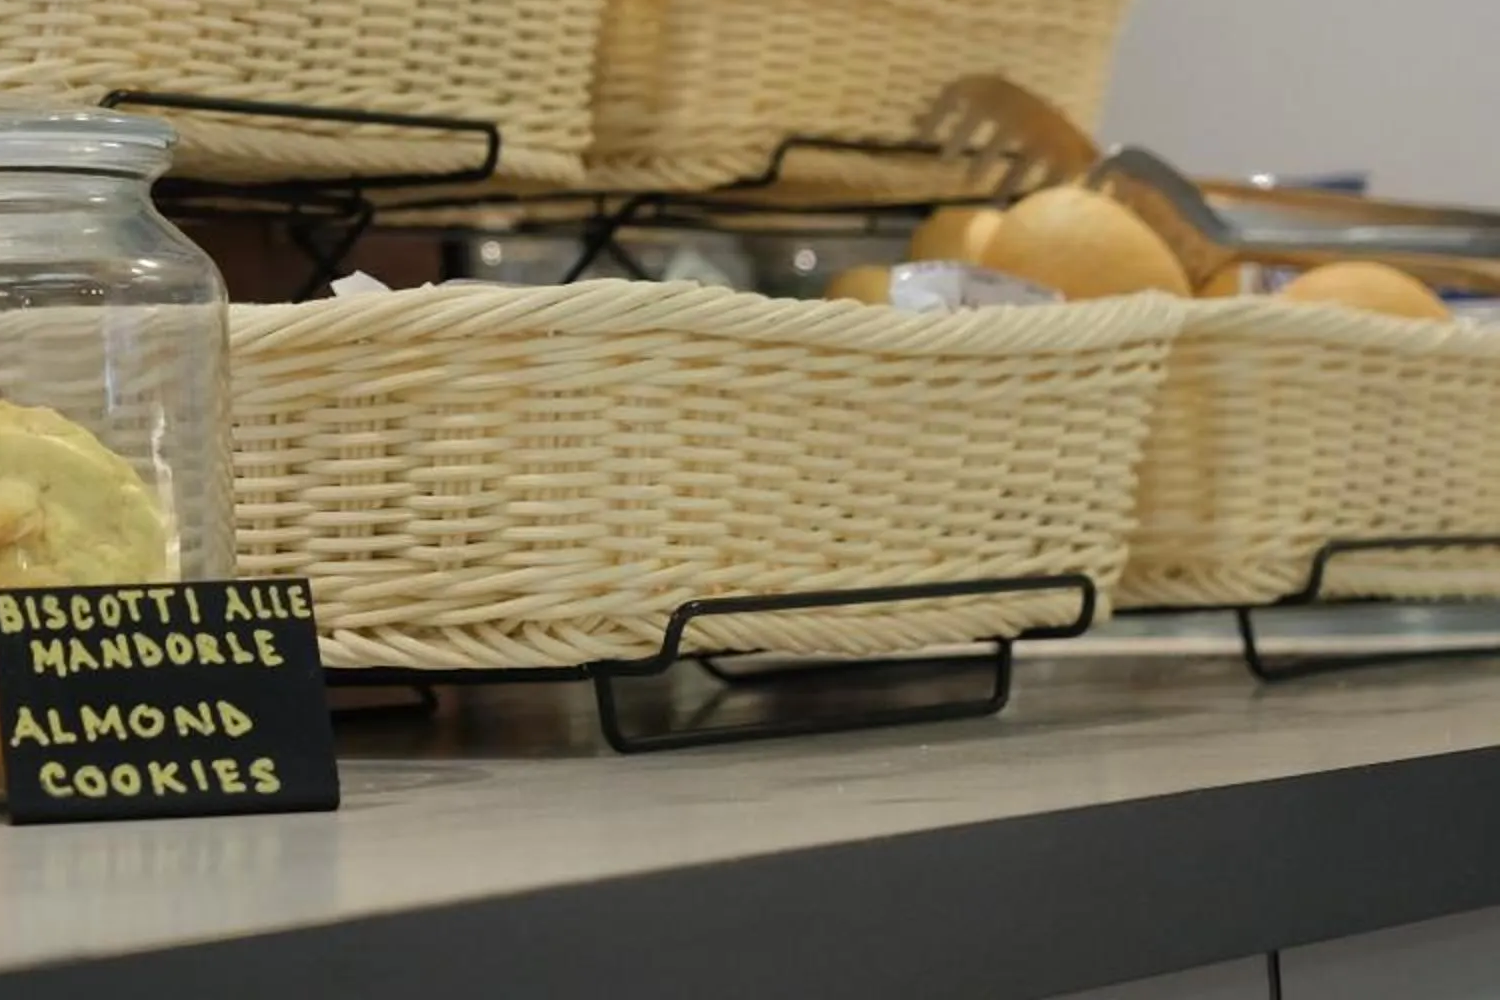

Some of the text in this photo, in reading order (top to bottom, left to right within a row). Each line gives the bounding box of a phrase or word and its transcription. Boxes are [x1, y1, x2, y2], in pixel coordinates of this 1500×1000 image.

[226, 584, 312, 621] ALLE
[31, 629, 284, 677] MANDORLE
[10, 700, 253, 747] ALMOND
[39, 757, 281, 798] COOKIES
